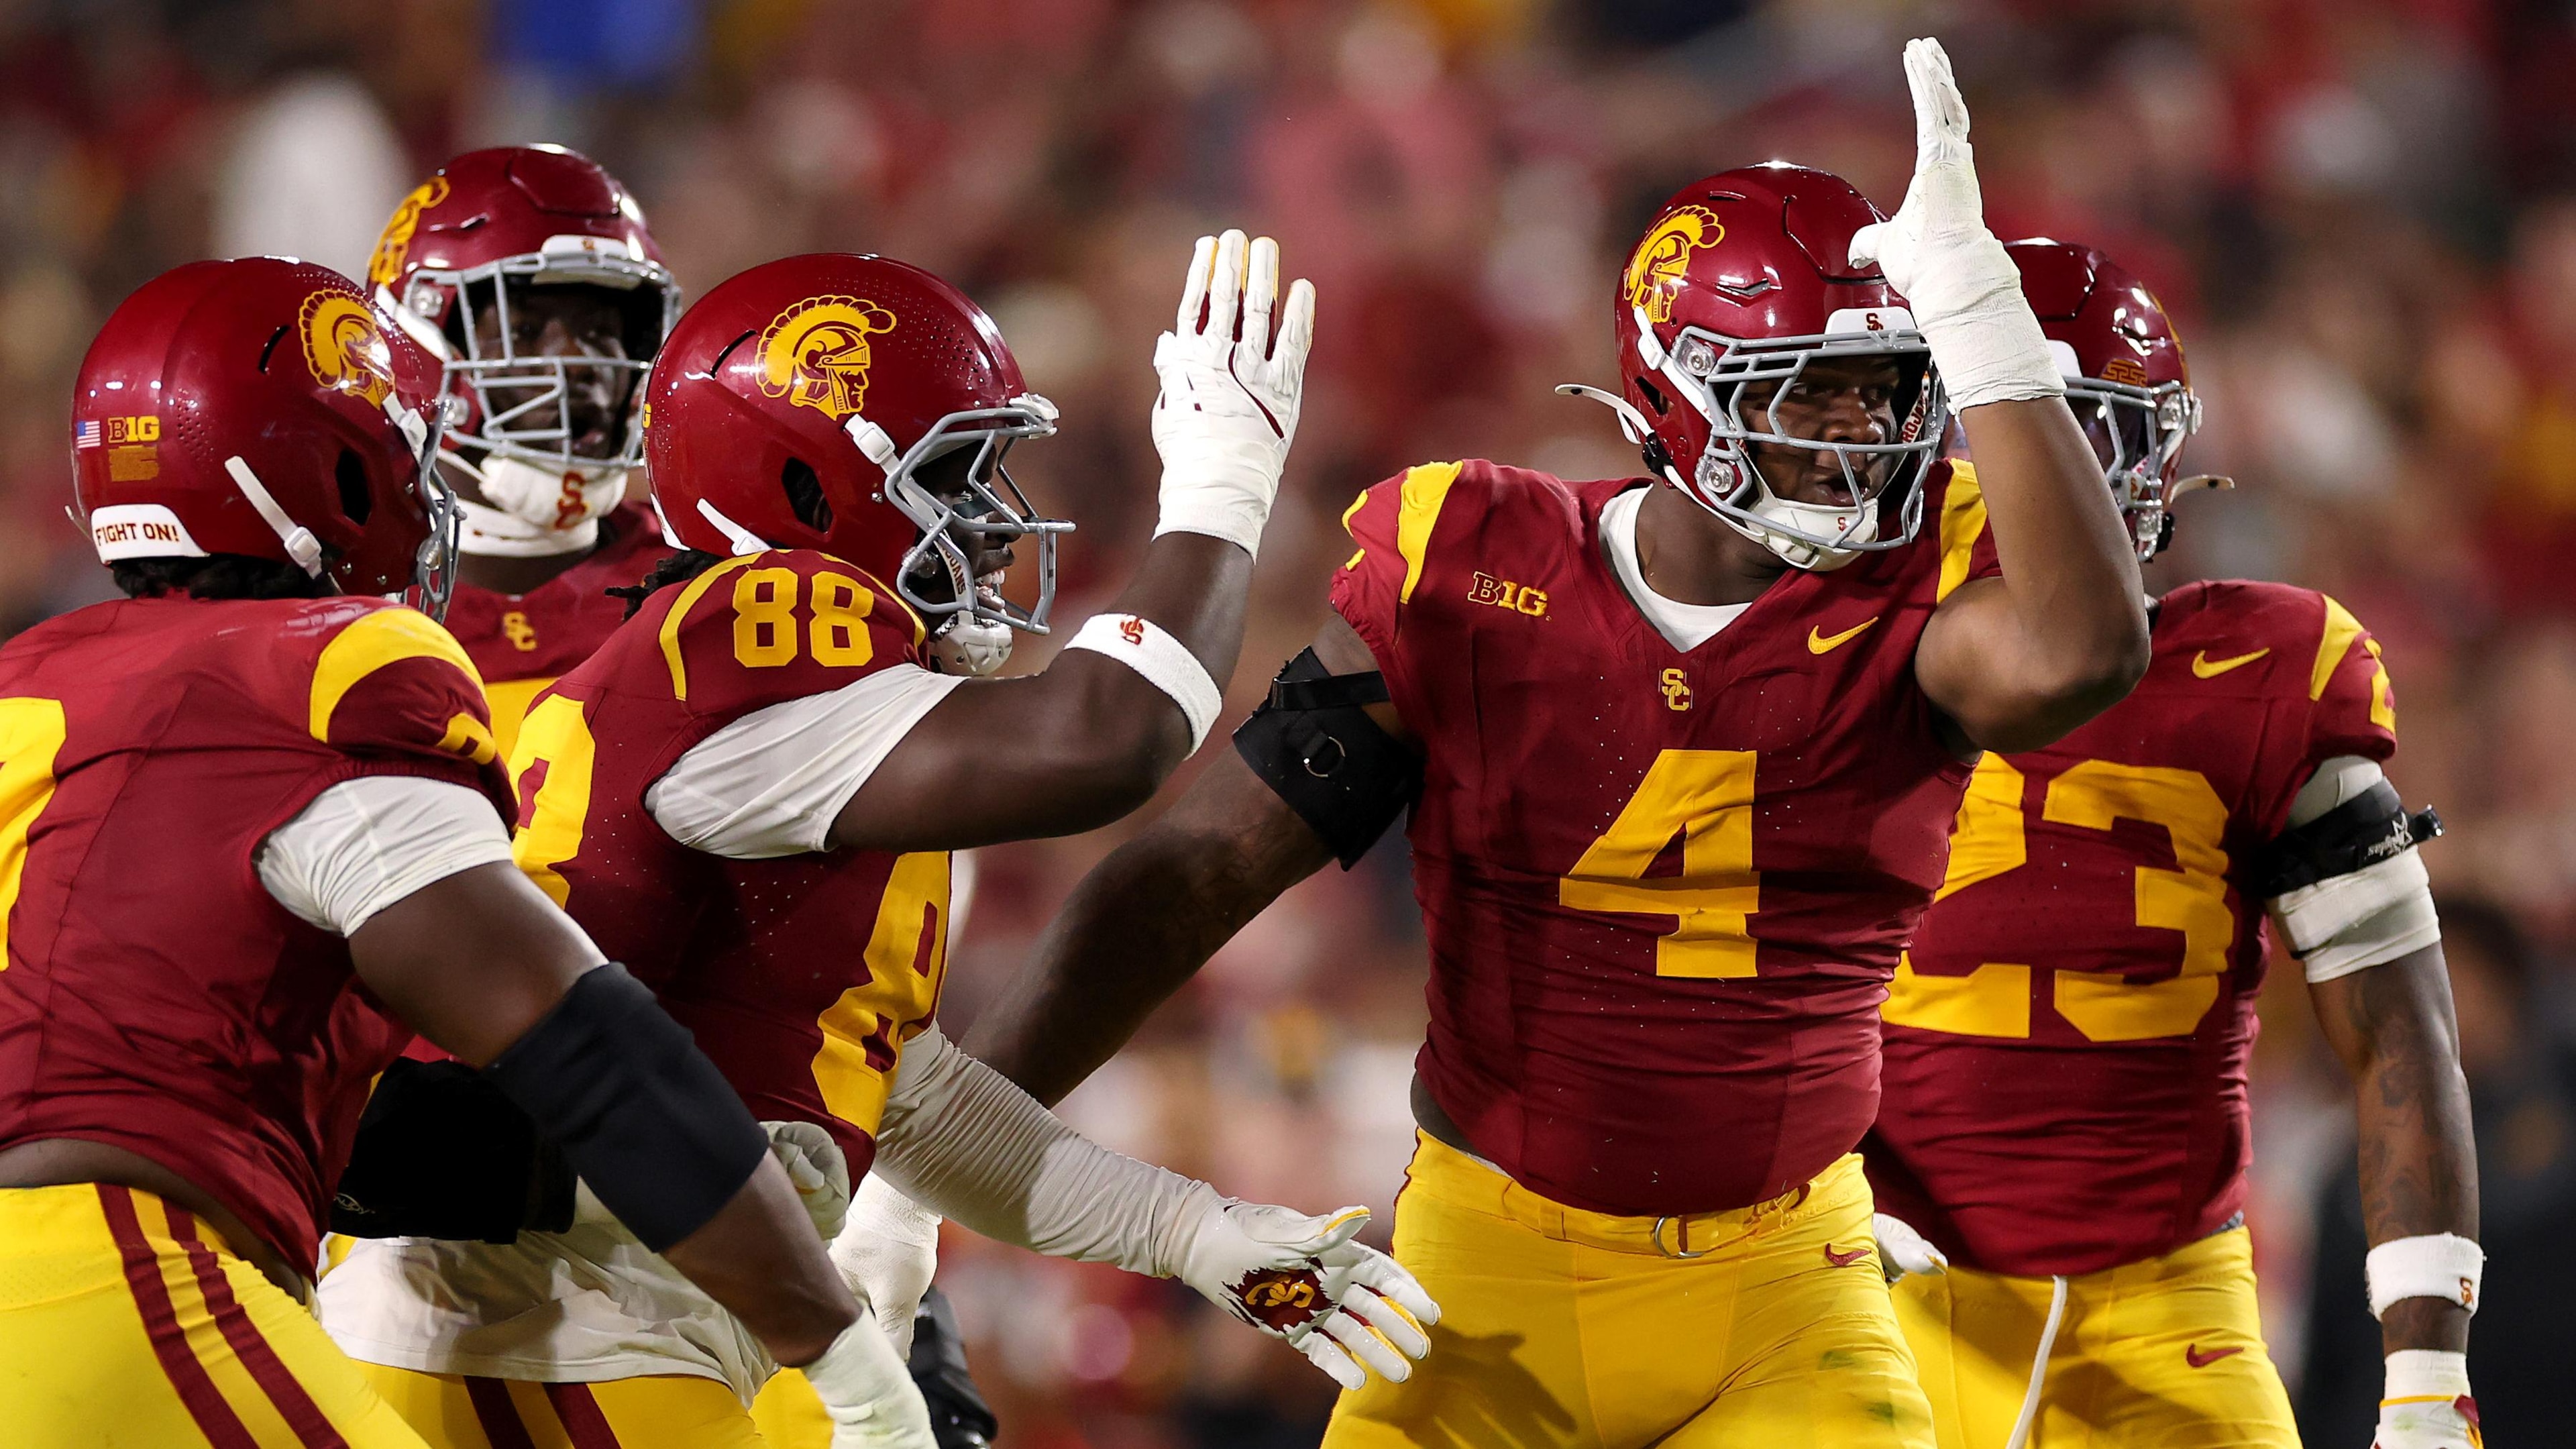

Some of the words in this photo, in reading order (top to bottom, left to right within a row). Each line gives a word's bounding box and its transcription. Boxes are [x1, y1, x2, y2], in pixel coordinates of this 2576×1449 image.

[95, 523, 136, 546] FIGHT
[143, 523, 180, 542] ON!
[733, 568, 874, 668] 88
[1662, 668, 1690, 711] SC
[1560, 749, 1760, 978] 4
[1878, 750, 2235, 1042] 23
